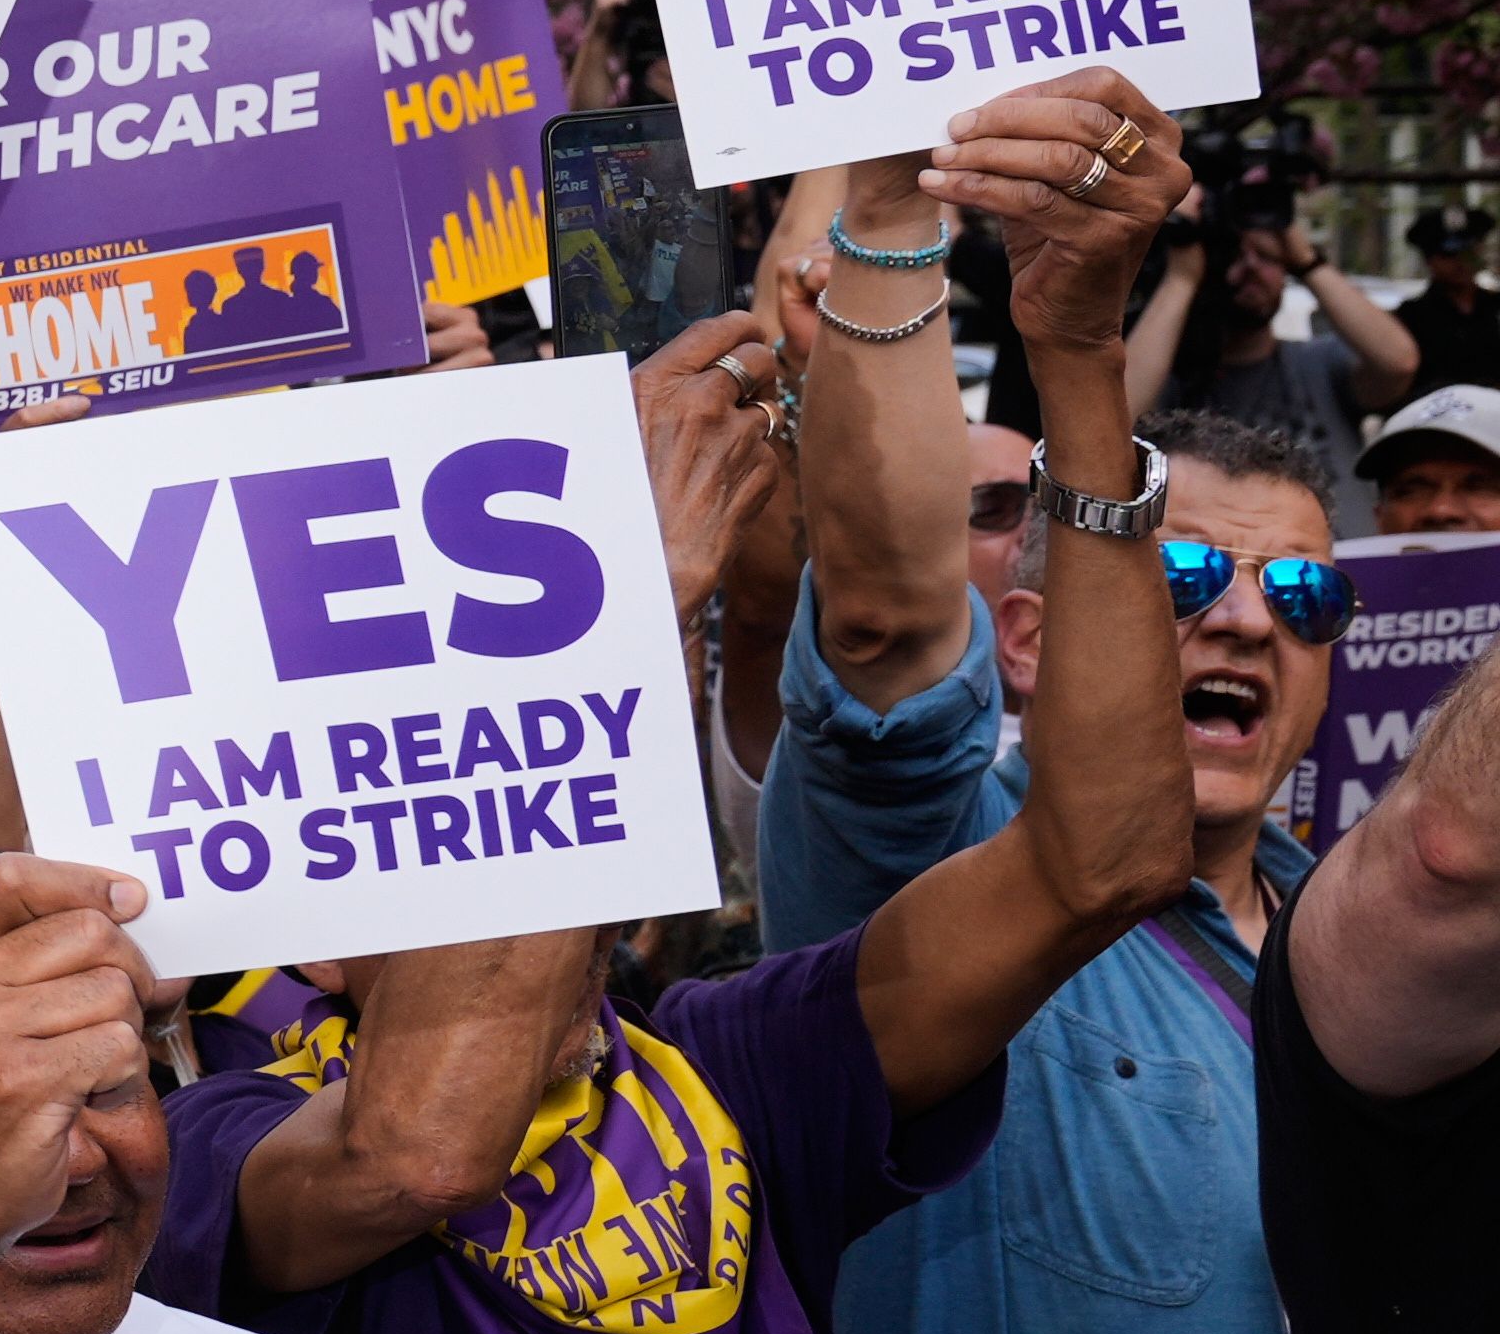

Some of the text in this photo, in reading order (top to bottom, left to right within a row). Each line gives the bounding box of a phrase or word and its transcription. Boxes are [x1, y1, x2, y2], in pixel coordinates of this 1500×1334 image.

[32, 18, 212, 99] OUR
[748, 38, 874, 108] TO
[384, 54, 536, 146] HOME
[9, 268, 123, 304] WE MAKE NYC
[15, 239, 149, 275] RESIDENTIAL
[108, 365, 175, 394] SEIU
[76, 687, 643, 828] I AM READY
[132, 773, 626, 901] TO STRIKE
